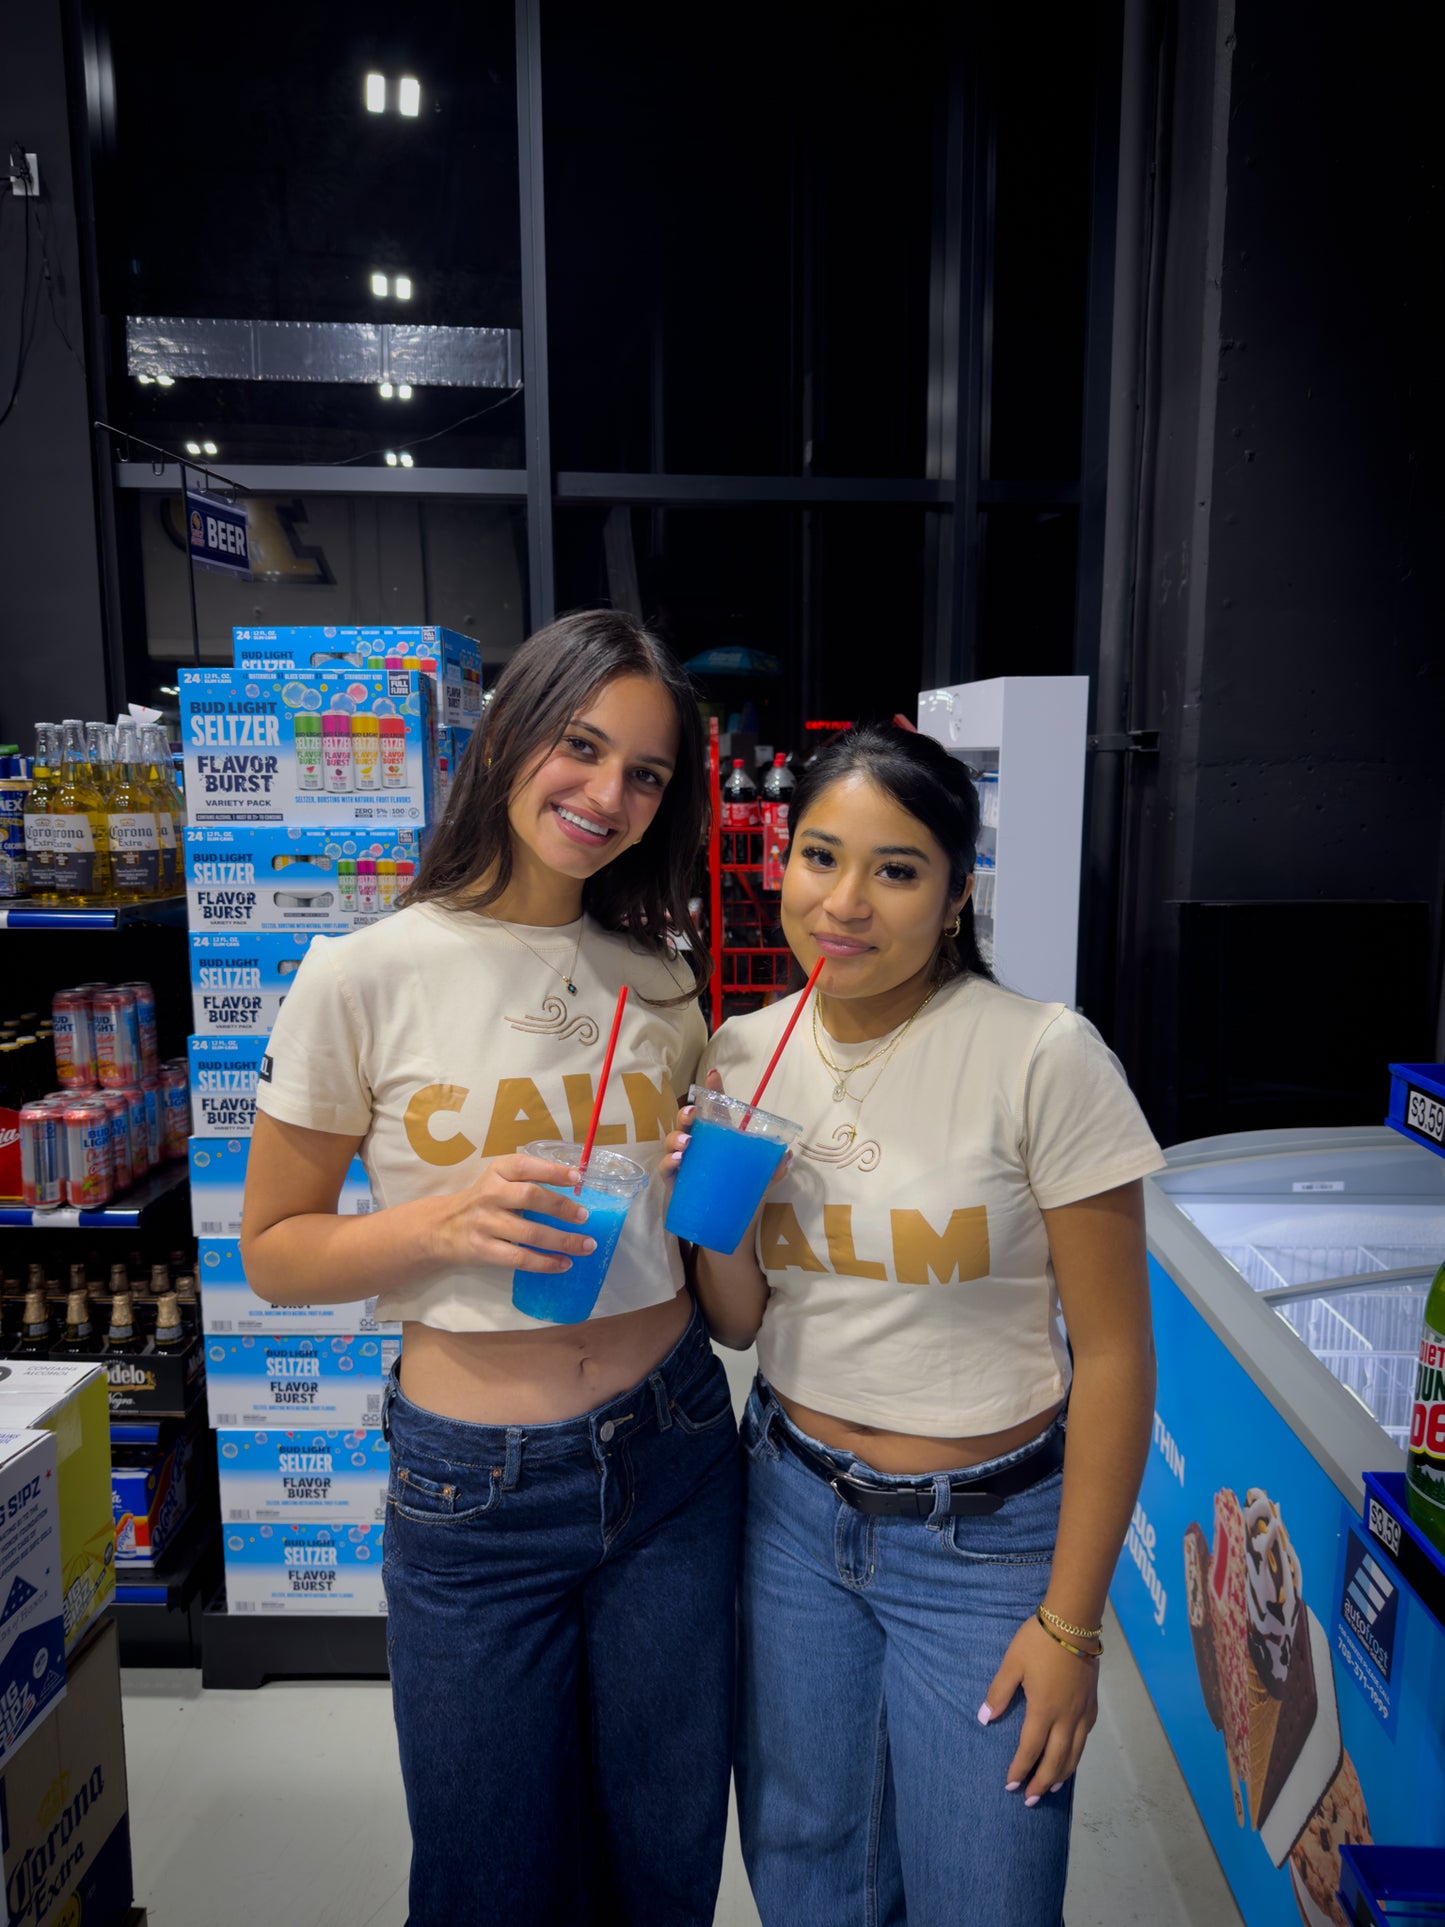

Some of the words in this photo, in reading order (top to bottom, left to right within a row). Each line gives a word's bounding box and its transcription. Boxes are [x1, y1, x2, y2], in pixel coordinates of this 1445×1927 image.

[207, 520, 246, 556] BEER
[236, 631, 250, 640] 24
[241, 651, 264, 660] BUD
[266, 651, 293, 660] LIGHT
[183, 673, 201, 684] 24
[190, 702, 225, 714] BUD
[228, 702, 277, 714] LIGHT
[191, 715, 280, 747] SELTZER
[198, 755, 279, 774] FLAVOR
[205, 775, 274, 793] BURST
[206, 799, 245, 807] VARIETY
[247, 799, 272, 807] PACK
[26, 825, 52, 839] Coro
[53, 825, 84, 839] orona
[108, 825, 153, 840] Corona
[187, 832, 203, 841] 24
[33, 839, 54, 847] Extr
[118, 839, 142, 847] Extra
[193, 854, 217, 862] BUD
[219, 853, 253, 862] LIGHT
[193, 863, 256, 885] SELTZER
[197, 891, 257, 905] FLAVOR
[203, 906, 253, 919] BURST
[193, 937, 210, 946] 24
[199, 958, 223, 967] BUD
[225, 958, 259, 967] LIGHT
[200, 968, 261, 989] SELTZER
[203, 996, 262, 1009] FLAVOR
[208, 1010, 258, 1023] BURST
[192, 1041, 208, 1050] 24
[198, 1061, 223, 1070] BUD
[224, 1061, 258, 1070] LIGHT
[198, 1071, 259, 1092] SELTZER
[202, 1098, 258, 1112] FLAVOR
[207, 1112, 256, 1125] BURST
[403, 1072, 678, 1166] CALM
[1411, 1096, 1444, 1137] $3.59
[83, 1137, 110, 1148] LIGH
[758, 1203, 991, 1285] ALM
[266, 1358, 320, 1376] SELTZER
[270, 1381, 319, 1393] FLAVOR
[275, 1393, 315, 1404] BURST
[279, 1454, 333, 1473] SELTZER
[283, 1477, 331, 1488] FLAVOR
[287, 1488, 328, 1499] BURST
[1371, 1504, 1399, 1552] $3.59
[284, 1547, 338, 1565] SELTZER
[288, 1570, 336, 1581] FLAVOR
[1124, 1522, 1167, 1626] unny
[293, 1581, 333, 1592] BURST
[1344, 1598, 1389, 1669] autofrost
[6, 1764, 104, 1921] Corona
[35, 1840, 84, 1923] Extra
